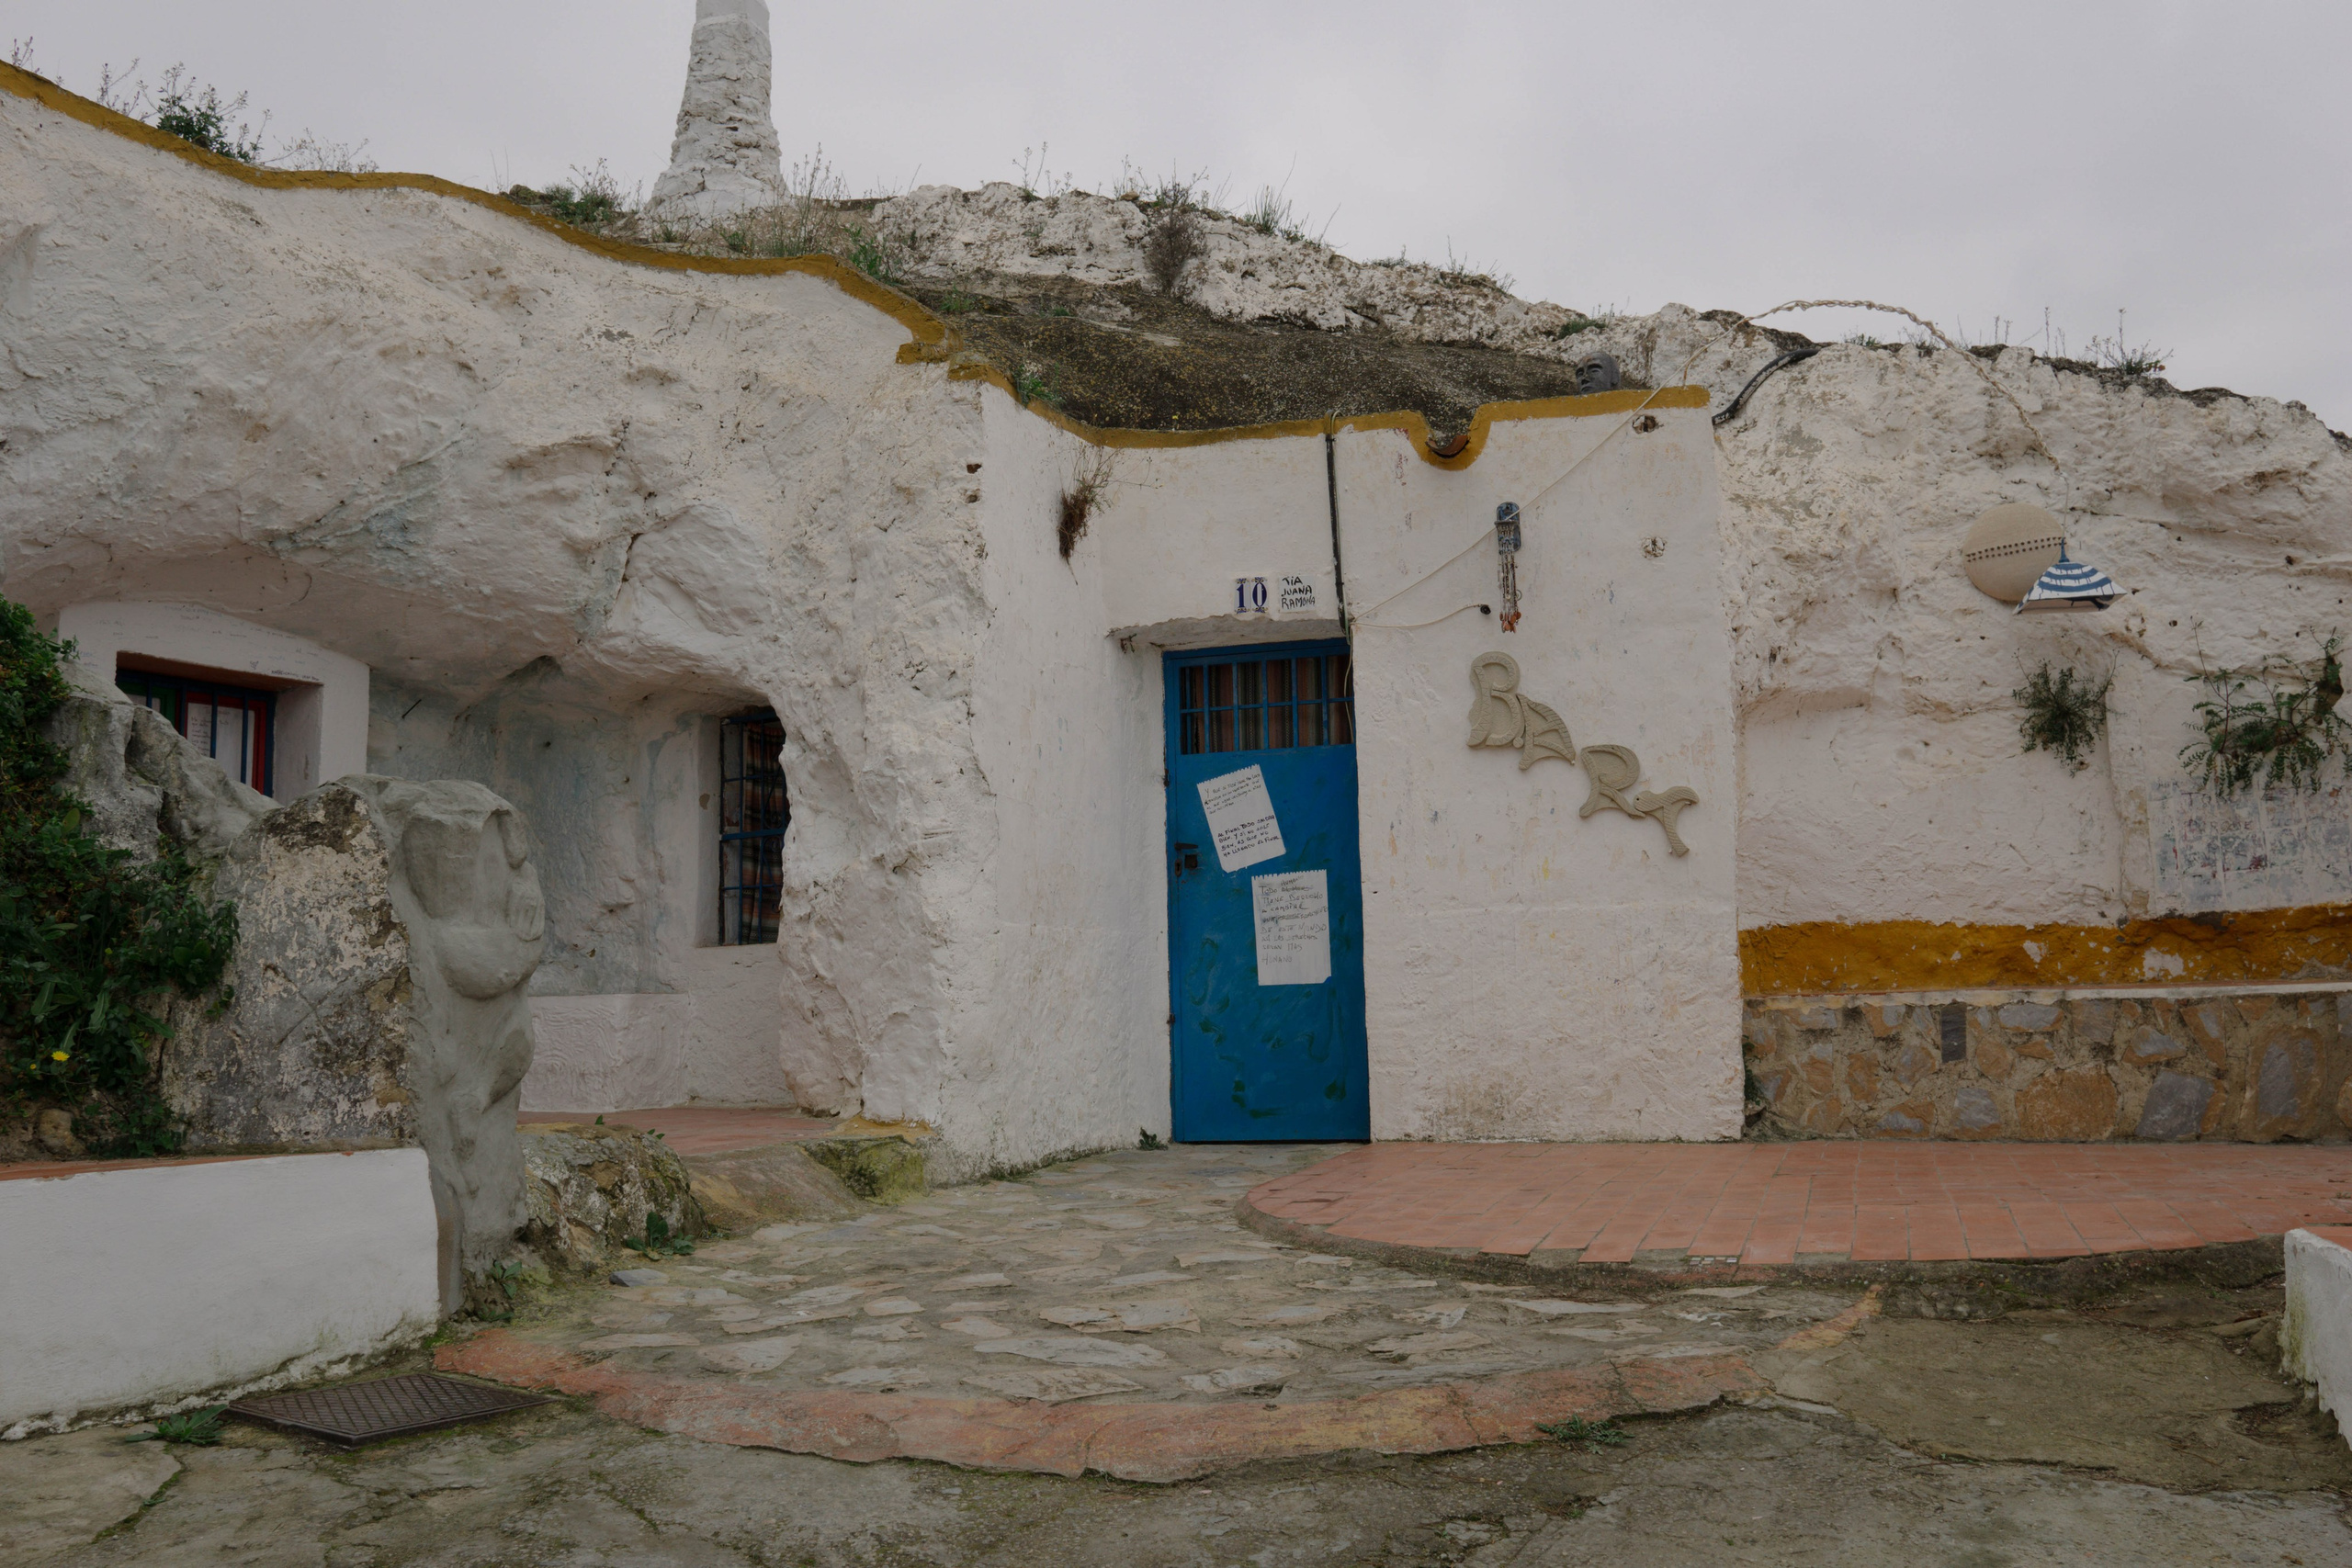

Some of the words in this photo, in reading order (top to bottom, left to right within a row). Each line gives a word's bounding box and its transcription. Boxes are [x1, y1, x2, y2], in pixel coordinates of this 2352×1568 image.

[1237, 582, 1268, 608] 10
[1281, 585, 1312, 597] JUANA
[1281, 595, 1316, 610] RAMONA
[1259, 886, 1278, 895] TODO
